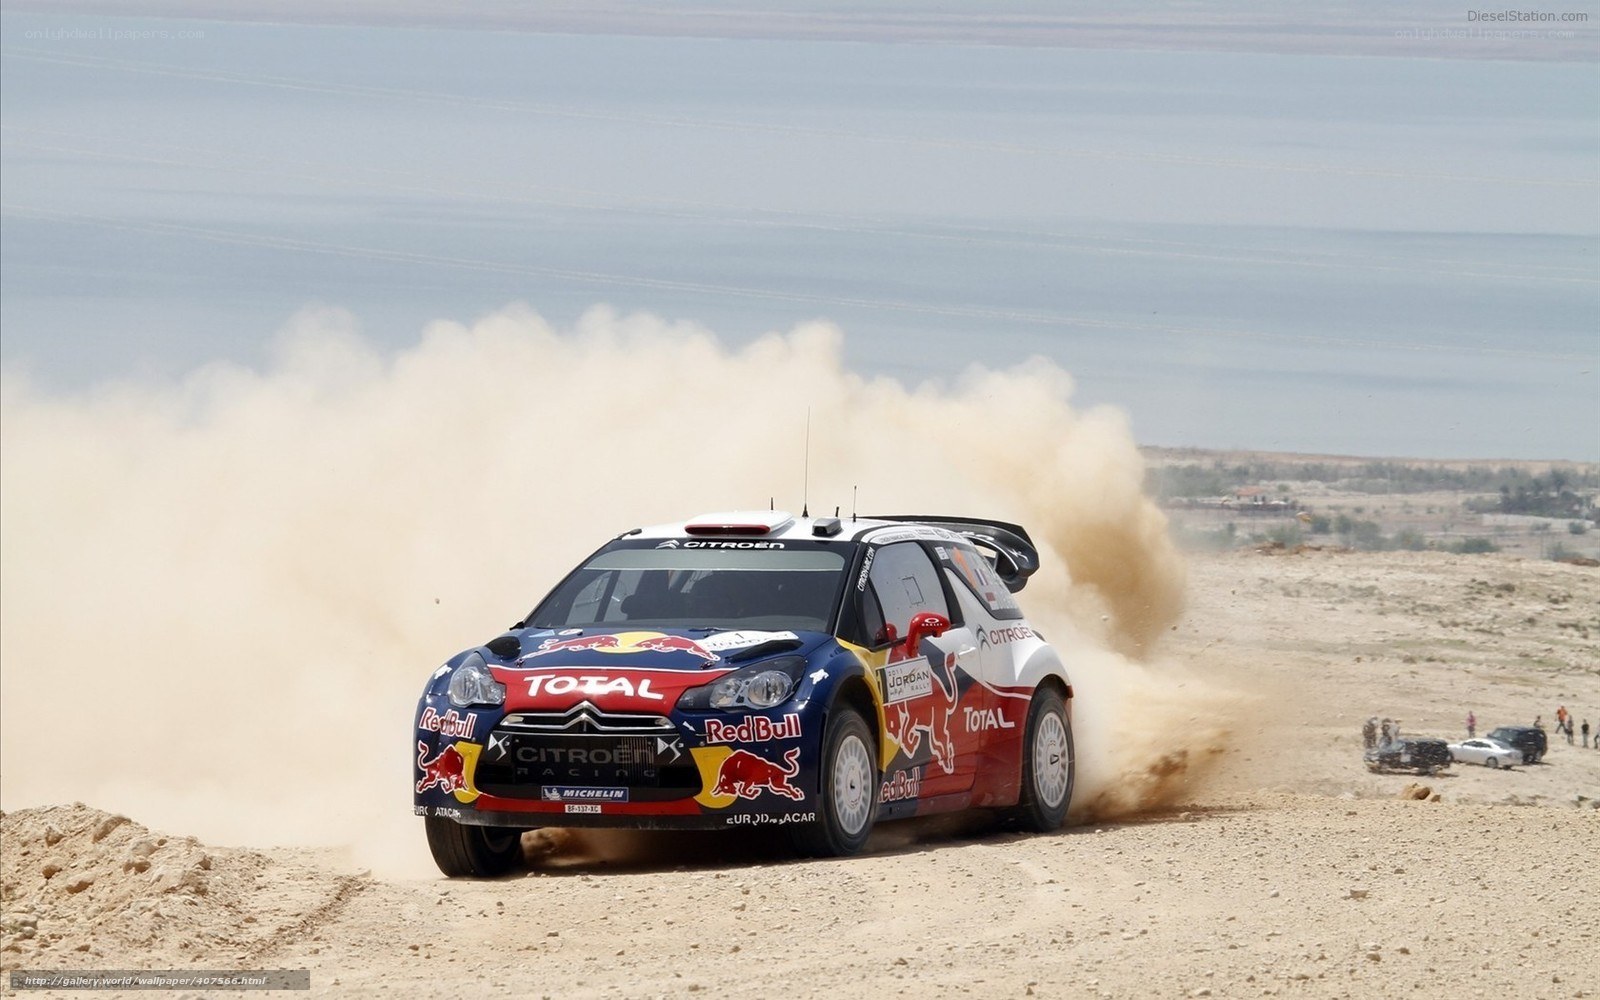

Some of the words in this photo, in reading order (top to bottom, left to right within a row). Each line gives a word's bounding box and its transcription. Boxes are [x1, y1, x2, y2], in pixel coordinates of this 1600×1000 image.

[524, 674, 664, 700] TOTAL
[889, 671, 930, 688] JORDAN
[705, 715, 754, 744] Red
[753, 713, 802, 742] Bull
[964, 707, 1015, 733] TOTAL
[517, 767, 656, 778] RACING
[563, 790, 624, 799] MICHELIN
